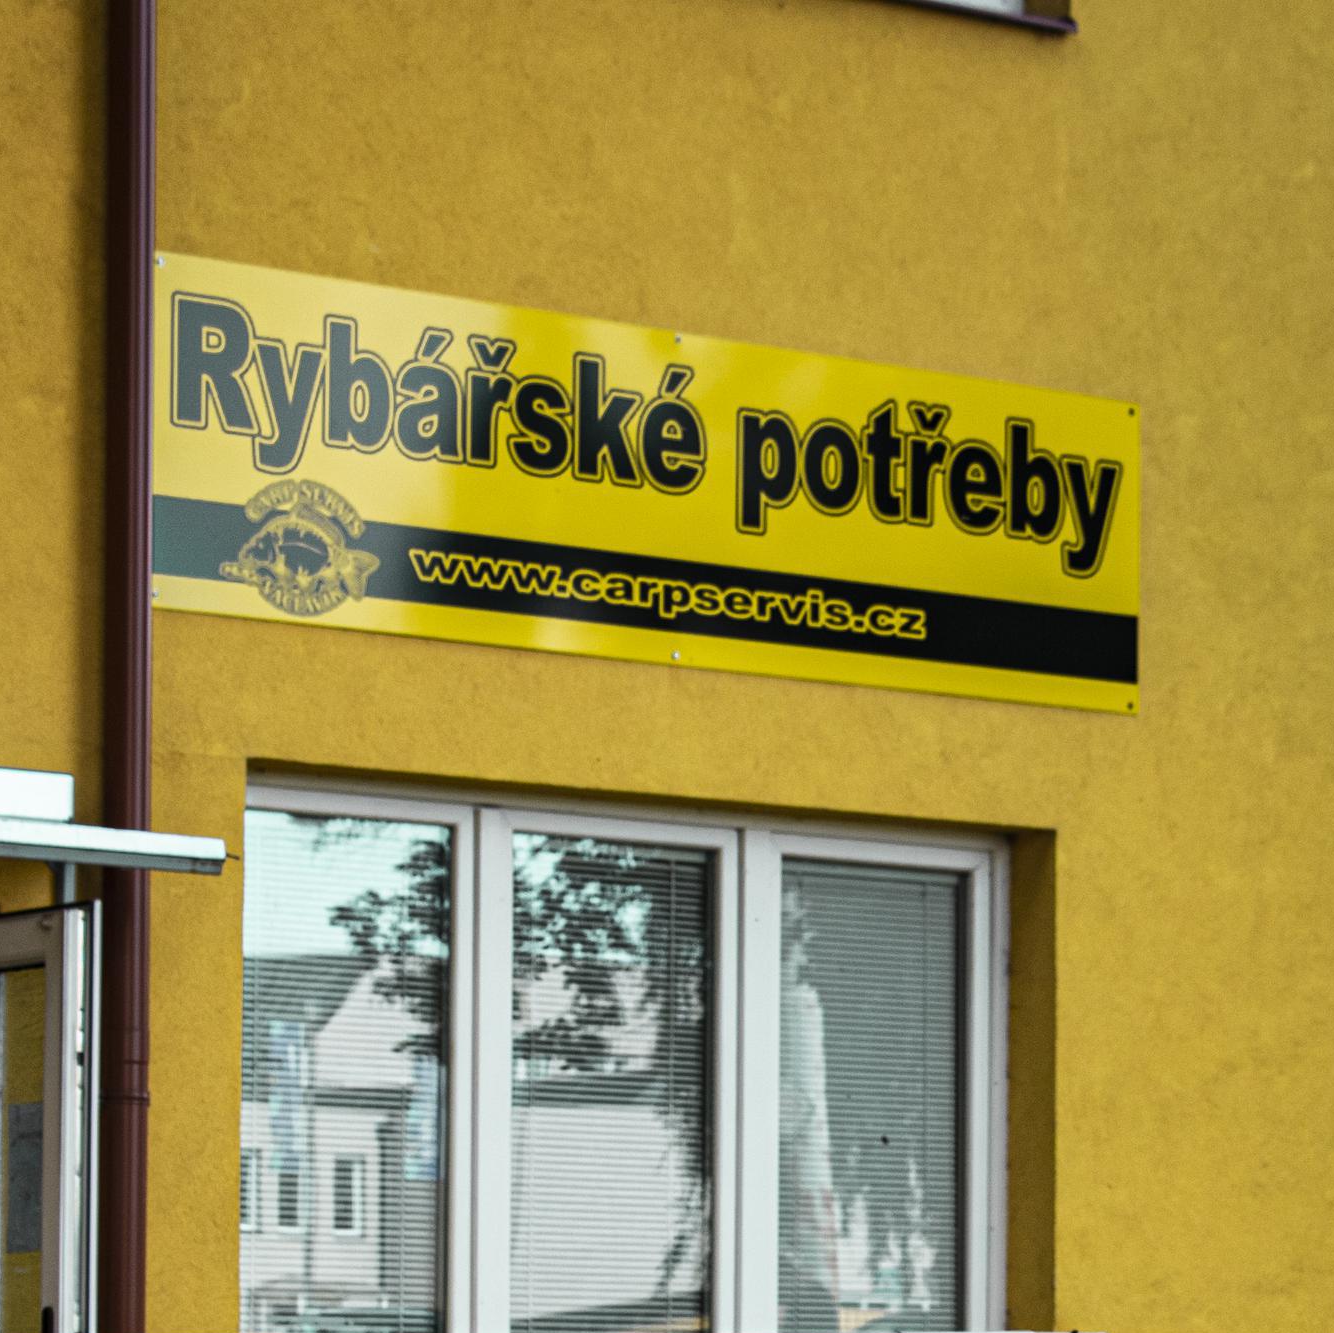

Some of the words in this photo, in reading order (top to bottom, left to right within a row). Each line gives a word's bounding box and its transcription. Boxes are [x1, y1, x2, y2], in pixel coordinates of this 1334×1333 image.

[172, 292, 707, 494] Rybářské
[736, 399, 1121, 578] potřeby
[408, 547, 927, 639] www.carpservis.cz
